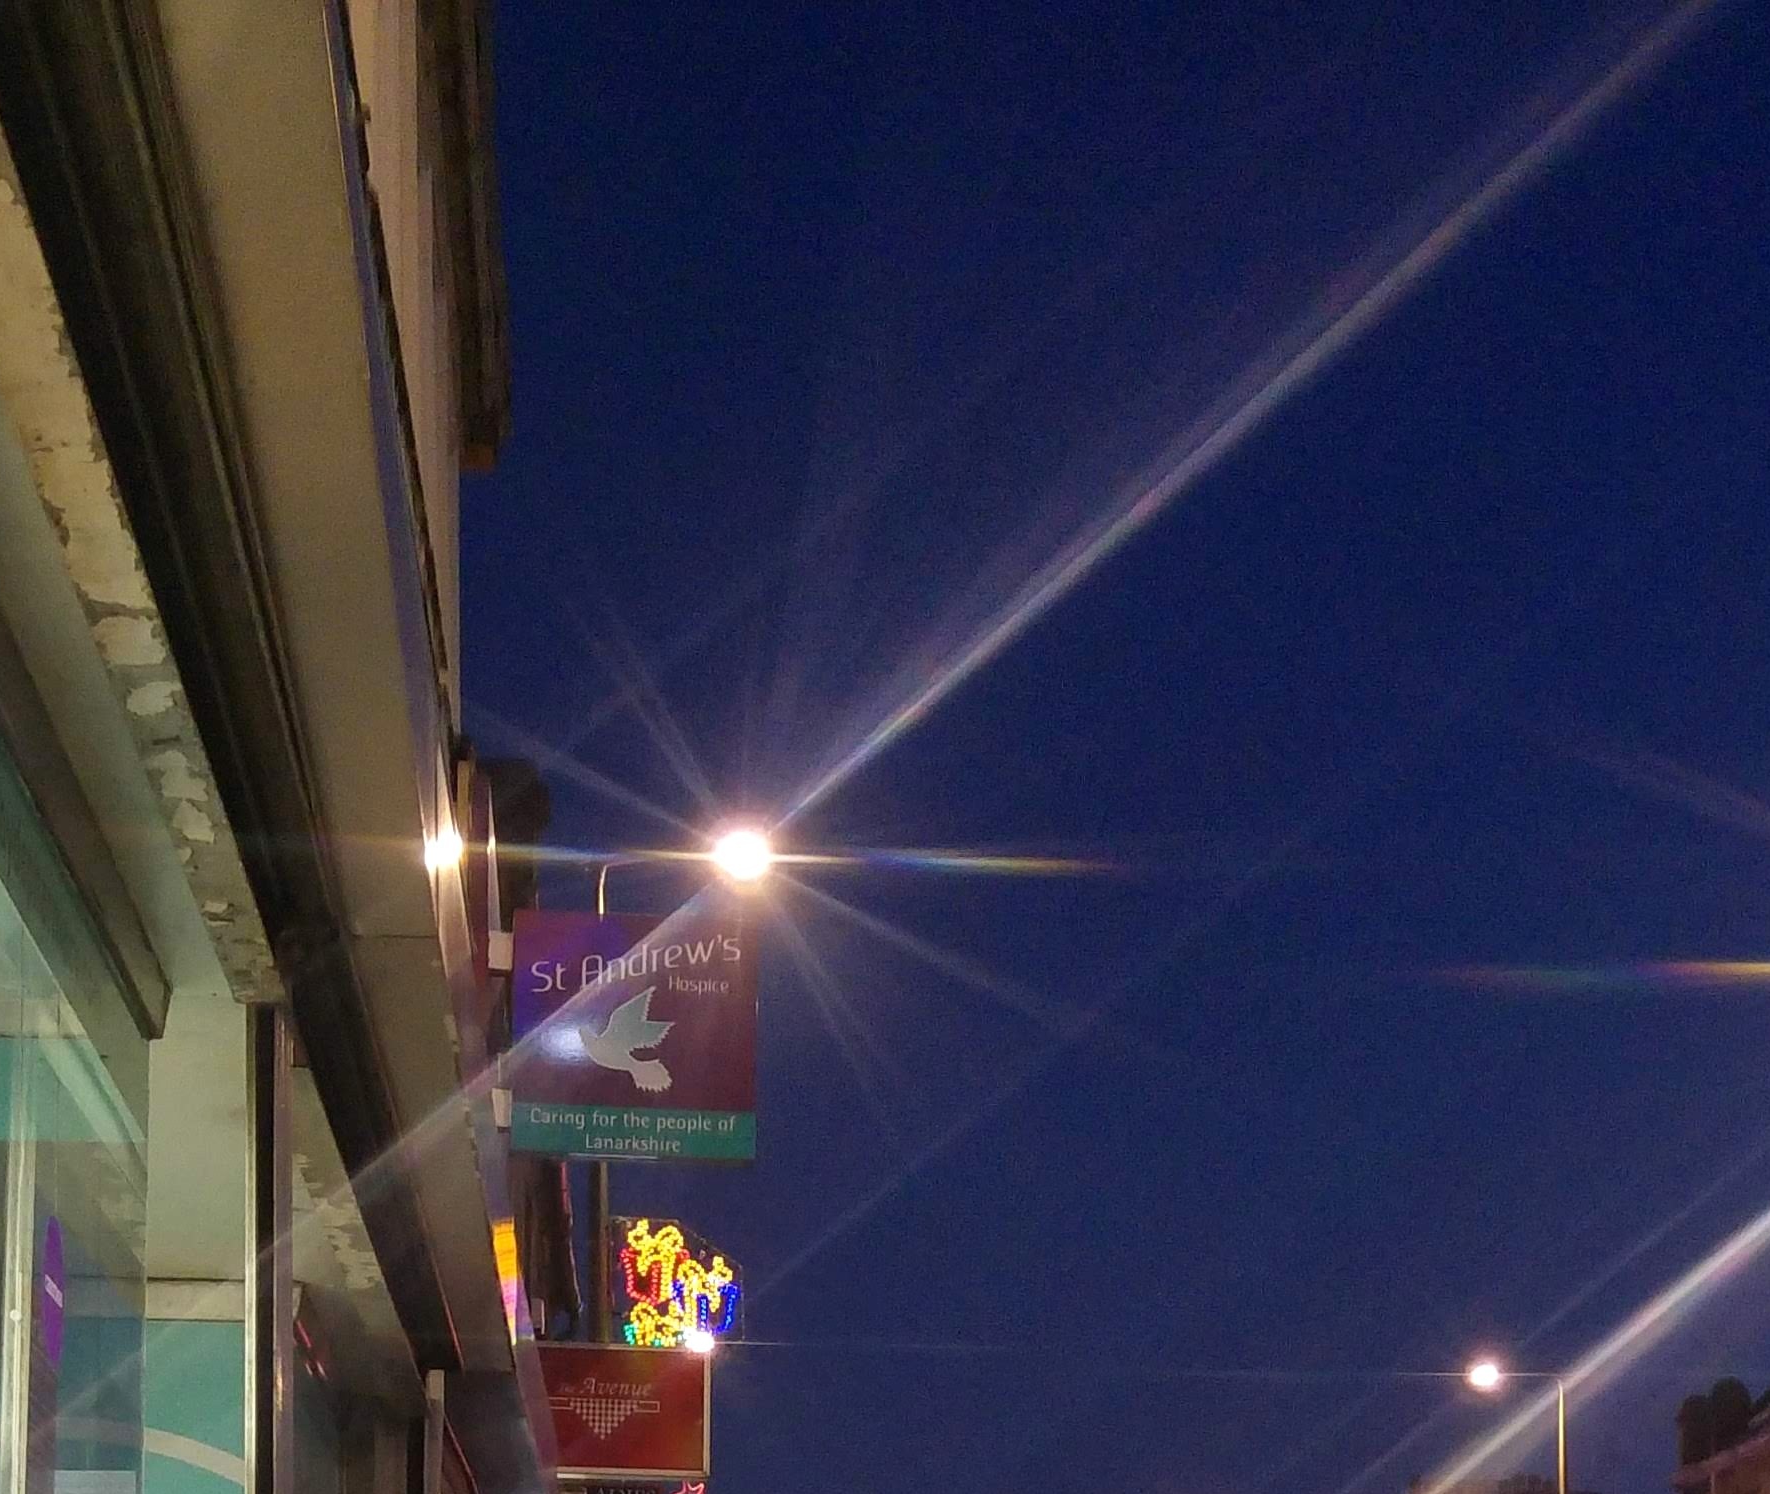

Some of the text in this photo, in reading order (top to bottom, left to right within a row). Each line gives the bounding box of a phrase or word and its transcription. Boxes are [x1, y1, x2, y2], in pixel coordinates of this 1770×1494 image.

[531, 933, 741, 993] St Andrew's
[668, 975, 729, 996] Hospice
[530, 1107, 737, 1134] Caring for the people of
[585, 1133, 681, 1153] Lanarkshire
[580, 1377, 653, 1398] Avenue
